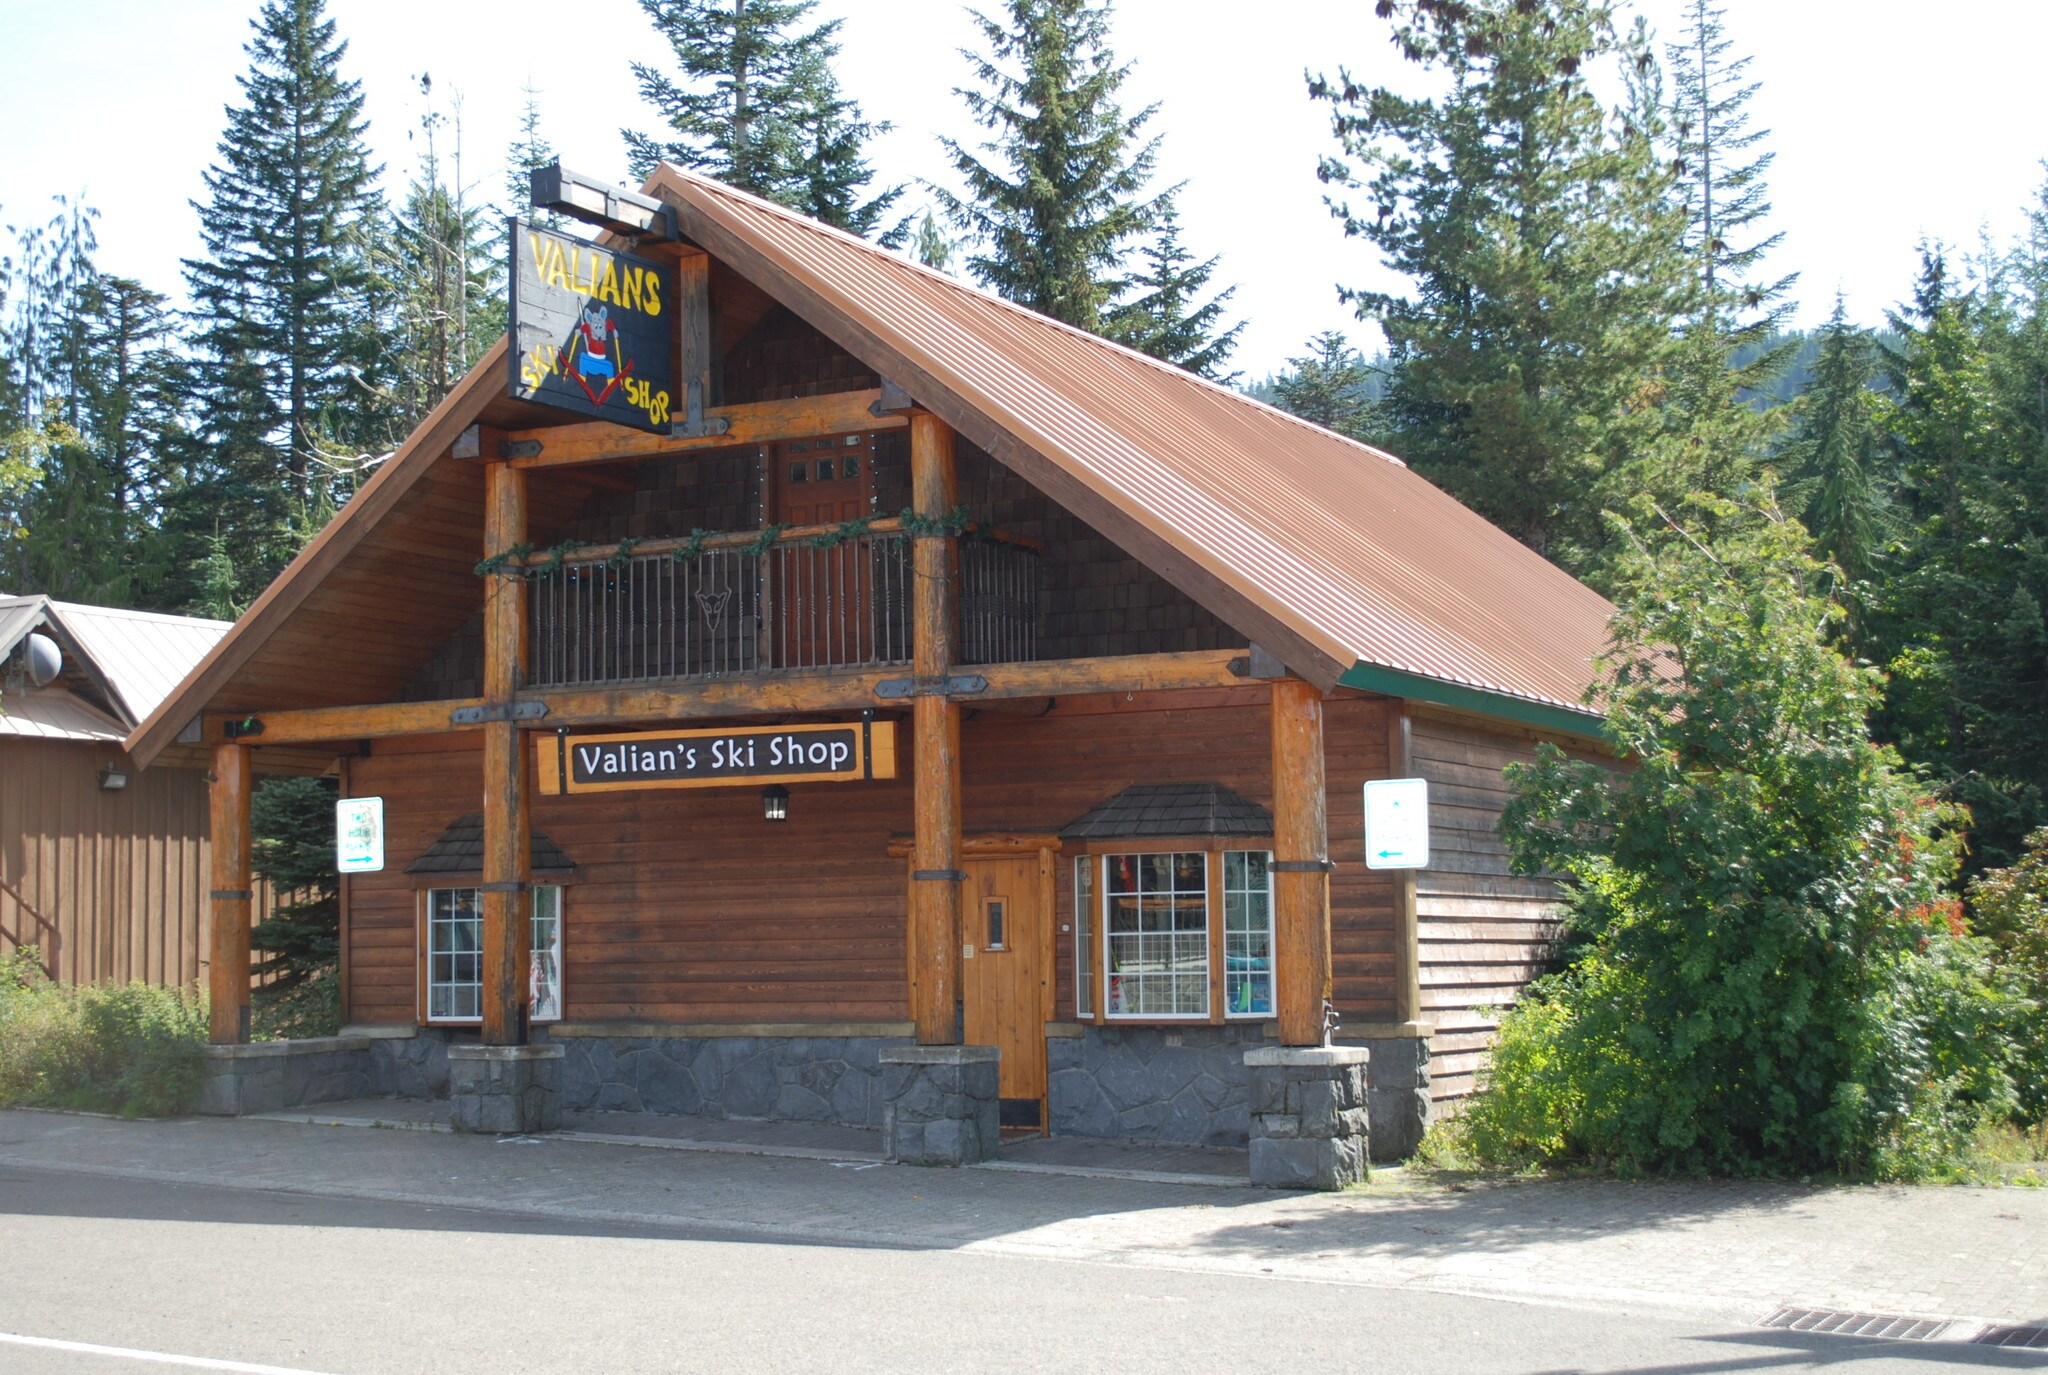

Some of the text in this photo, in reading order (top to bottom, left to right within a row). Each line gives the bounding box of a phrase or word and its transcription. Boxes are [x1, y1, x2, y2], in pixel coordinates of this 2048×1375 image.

[529, 233, 661, 316] VALIANS
[522, 343, 669, 425] SKI SHOP
[580, 736, 849, 775] Valian's Ski Shop
